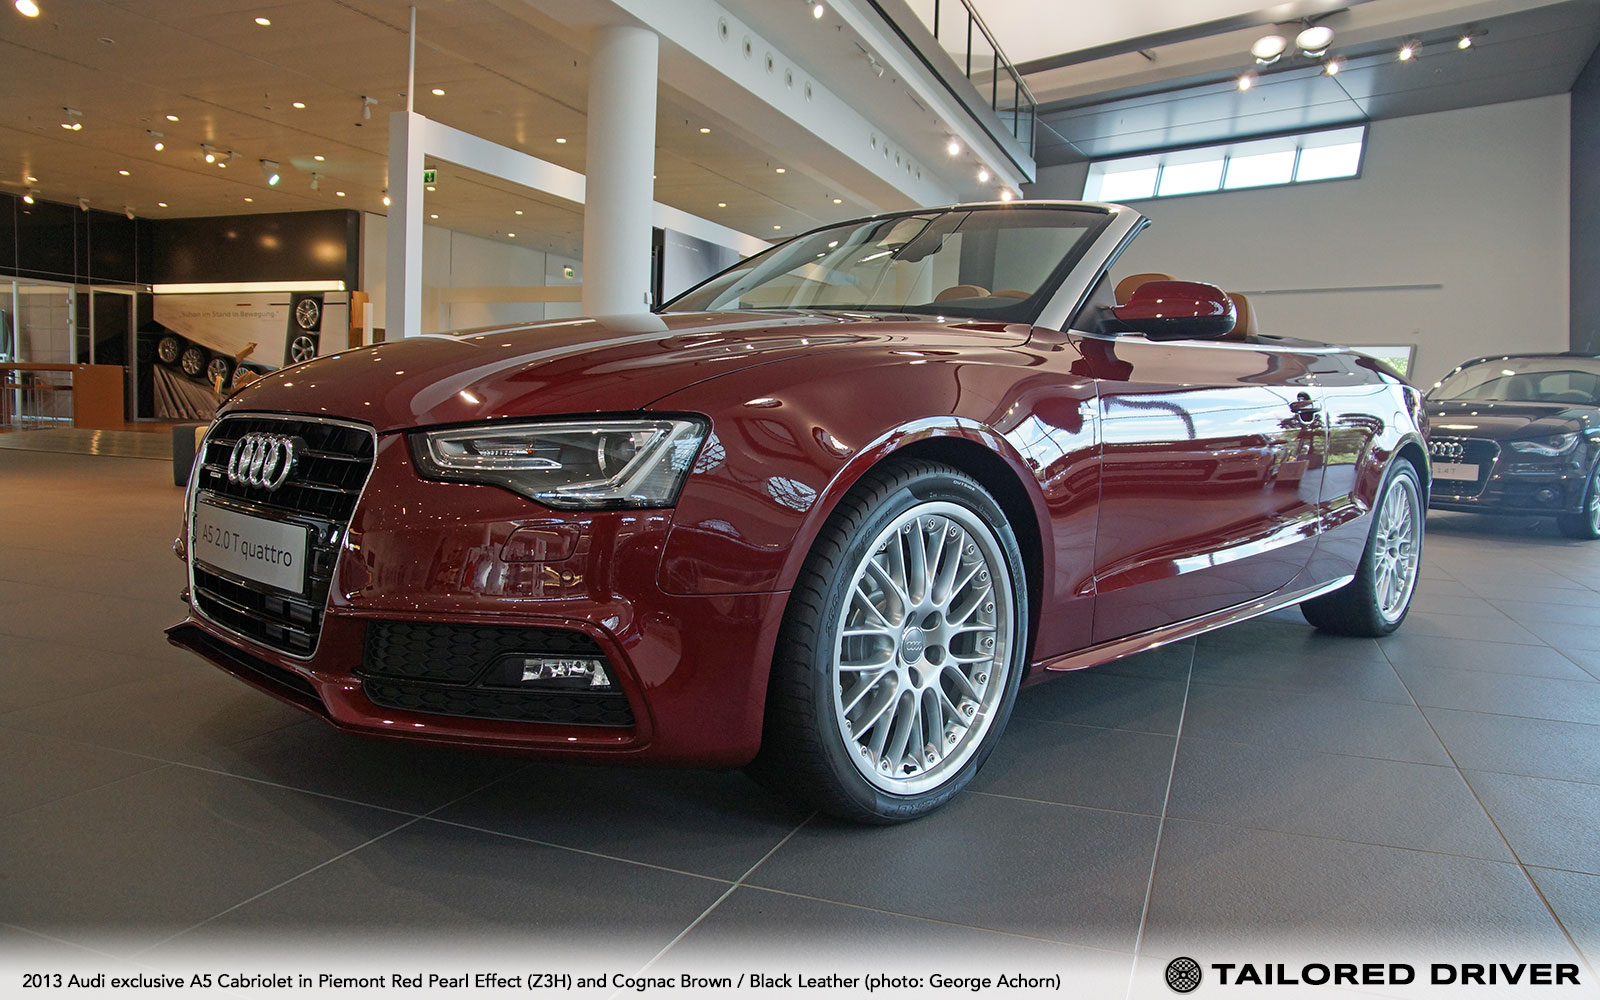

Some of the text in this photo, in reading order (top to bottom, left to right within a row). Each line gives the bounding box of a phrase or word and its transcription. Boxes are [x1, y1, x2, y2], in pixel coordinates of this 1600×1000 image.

[202, 524, 293, 567] A5 2.0 T quattro
